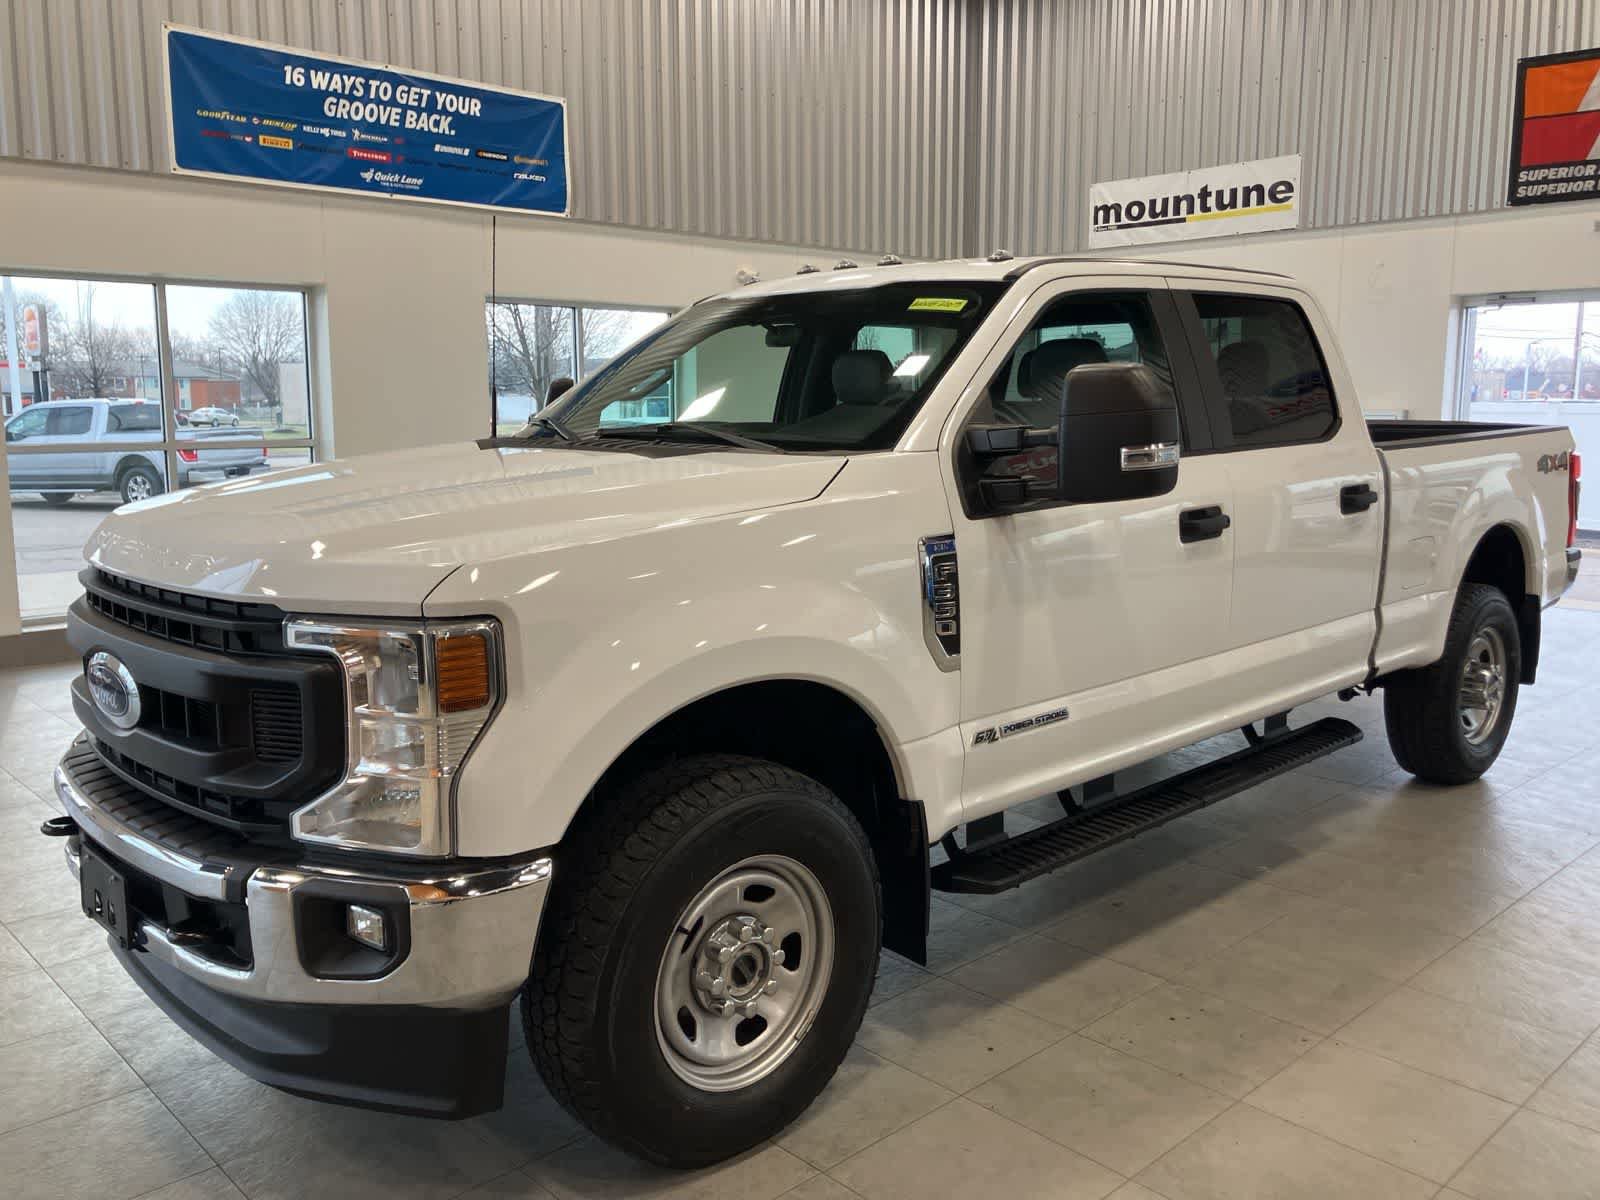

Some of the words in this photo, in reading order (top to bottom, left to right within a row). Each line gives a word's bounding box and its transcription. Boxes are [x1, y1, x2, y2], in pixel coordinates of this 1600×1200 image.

[284, 65, 305, 87] 16
[310, 70, 366, 97] WAYS
[368, 79, 392, 102] TO
[395, 85, 431, 108] GET
[435, 91, 482, 117] YOUR
[196, 109, 247, 123] GOODYEAR
[262, 119, 298, 130] DUNLOP
[323, 96, 402, 127] GROOVE
[405, 110, 456, 136] BACK.
[374, 170, 400, 183] Quick
[401, 174, 424, 186] Lane
[513, 172, 546, 182] FALKEN
[1517, 163, 1598, 183] SUPERIOR
[1516, 179, 1596, 198] SUPERIOR
[1093, 179, 1295, 226] mountune
[1003, 718, 1034, 734] POWER
[1034, 707, 1069, 725] STROKE
